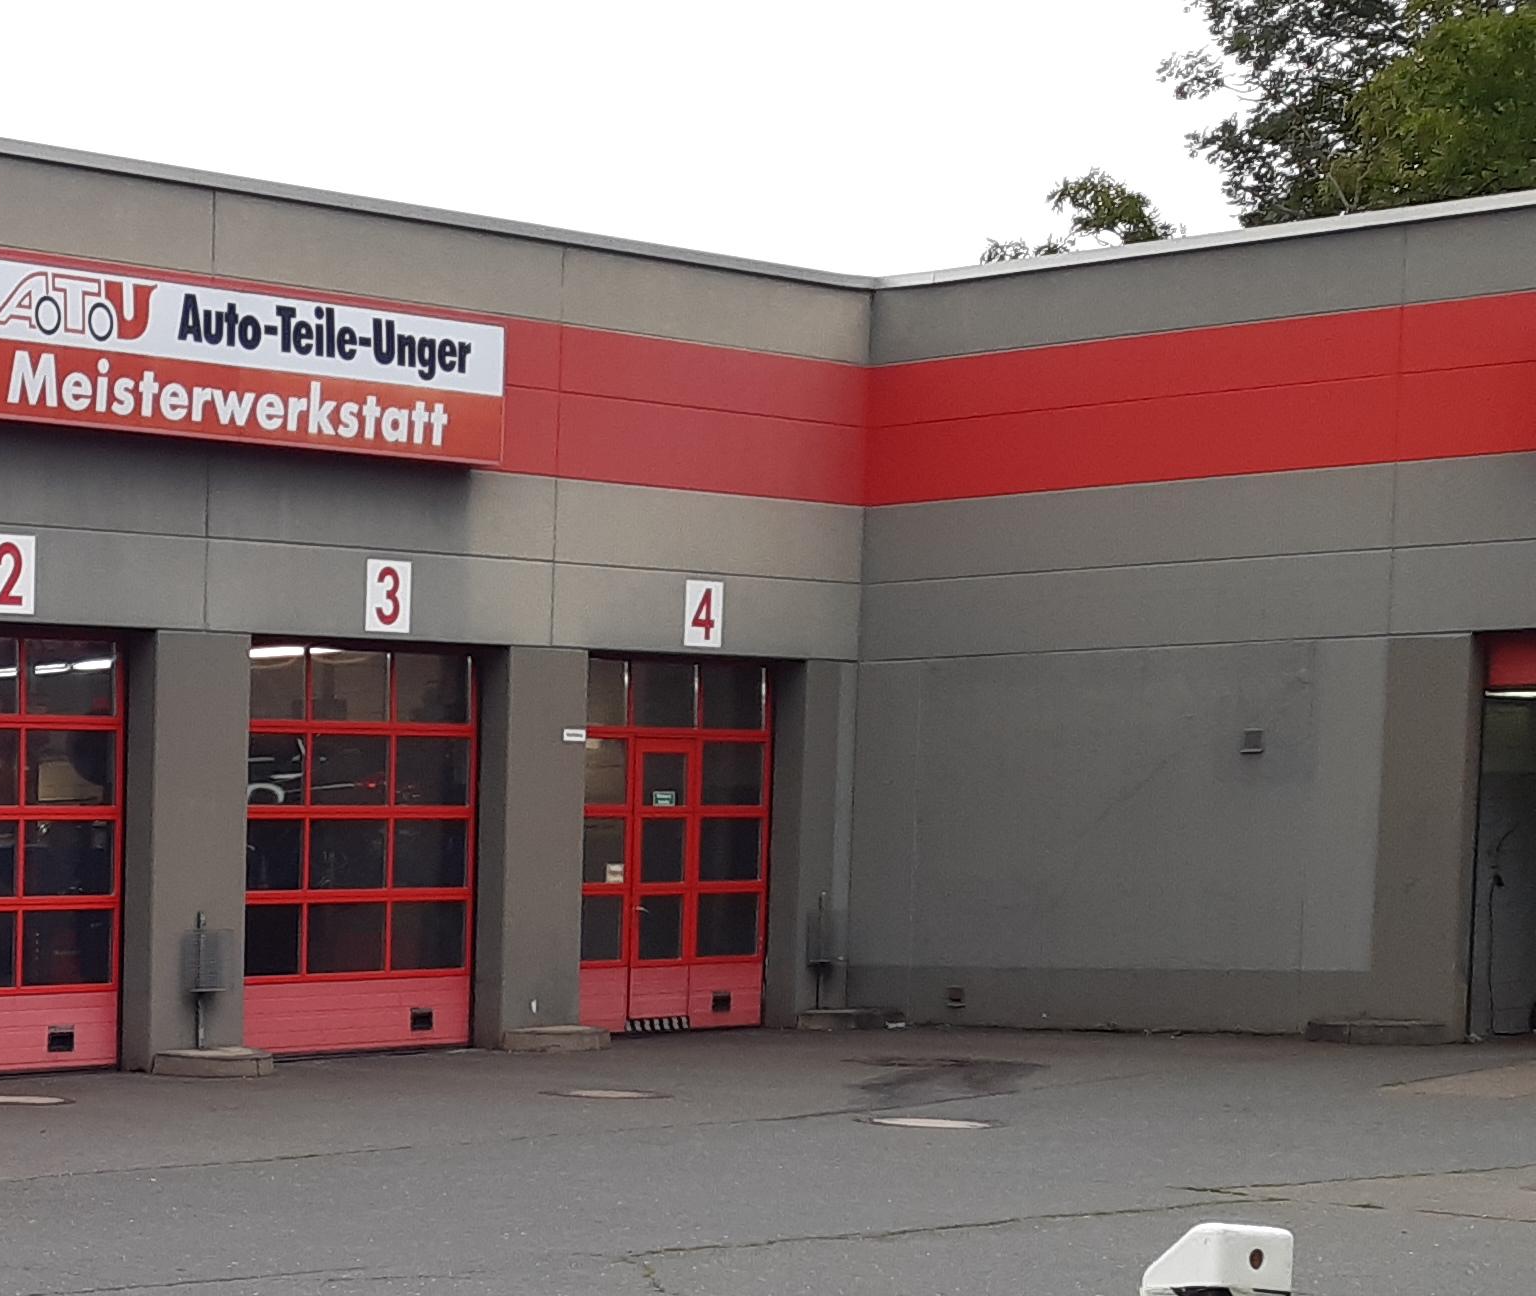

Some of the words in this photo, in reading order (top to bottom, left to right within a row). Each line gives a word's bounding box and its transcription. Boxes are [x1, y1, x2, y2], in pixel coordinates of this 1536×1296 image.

[178, 293, 472, 380] Auto-Teile-Unger
[7, 350, 448, 446] Meisterwerkstatt
[375, 566, 401, 626] 3
[691, 588, 716, 641] 4
